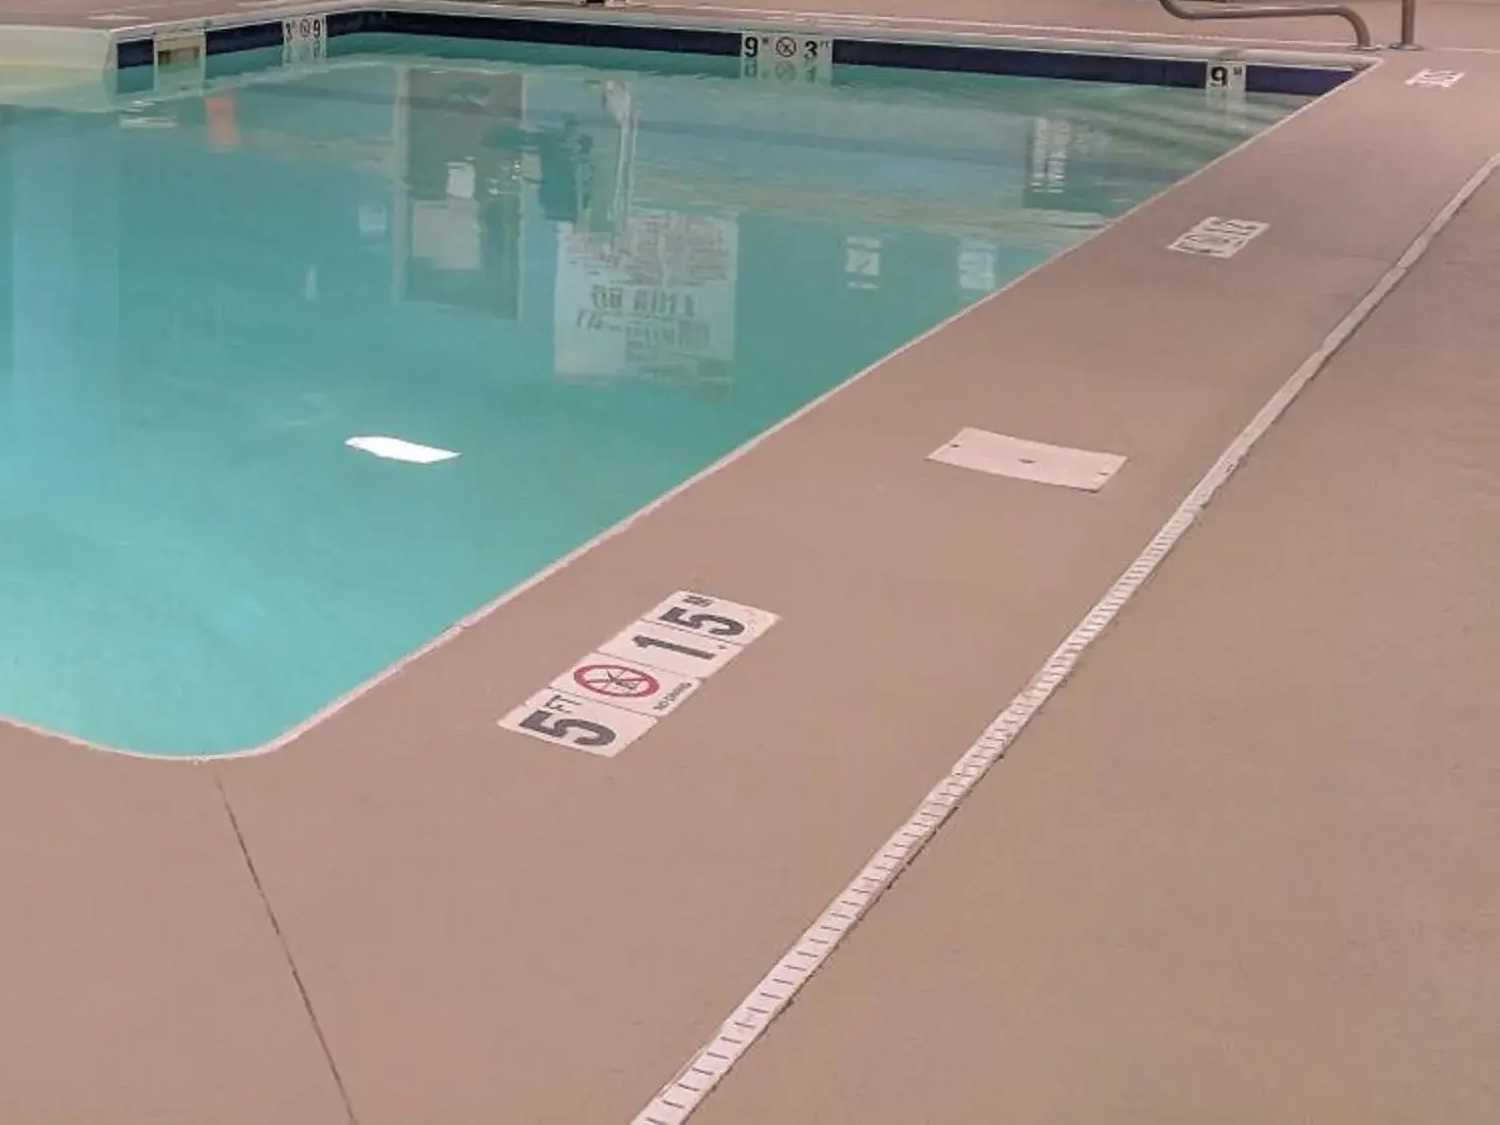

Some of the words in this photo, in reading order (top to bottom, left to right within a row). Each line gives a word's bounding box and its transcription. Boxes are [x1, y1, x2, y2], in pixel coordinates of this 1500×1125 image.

[745, 36, 758, 57] 9
[804, 40, 818, 59] 3
[1211, 66, 1228, 87] 9
